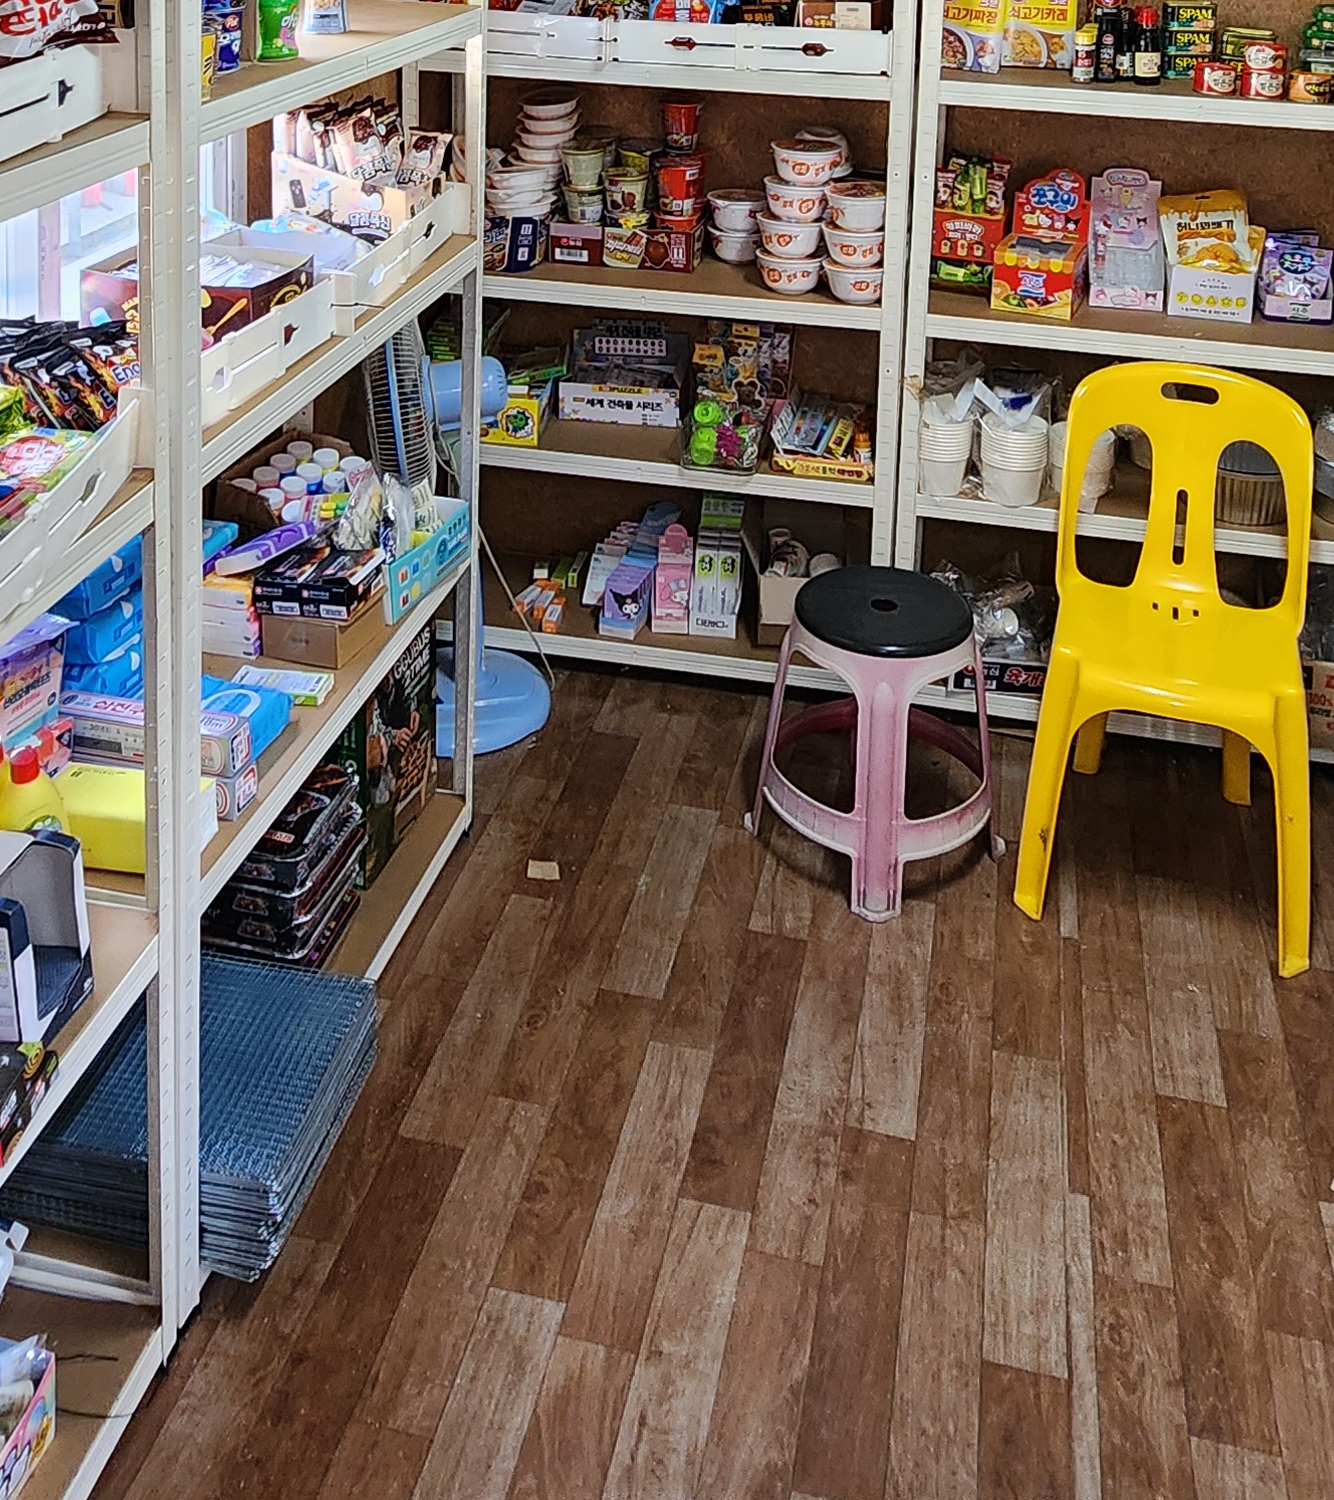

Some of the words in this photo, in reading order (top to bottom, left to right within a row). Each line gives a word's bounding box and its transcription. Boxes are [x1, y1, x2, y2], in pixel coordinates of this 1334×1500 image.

[1008, 6, 1067, 22] 쇠고기카레
[1178, 7, 1213, 20] SPAM
[1176, 32, 1210, 45] SPAM
[585, 398, 606, 409] 세계
[636, 401, 664, 412] 시리즈
